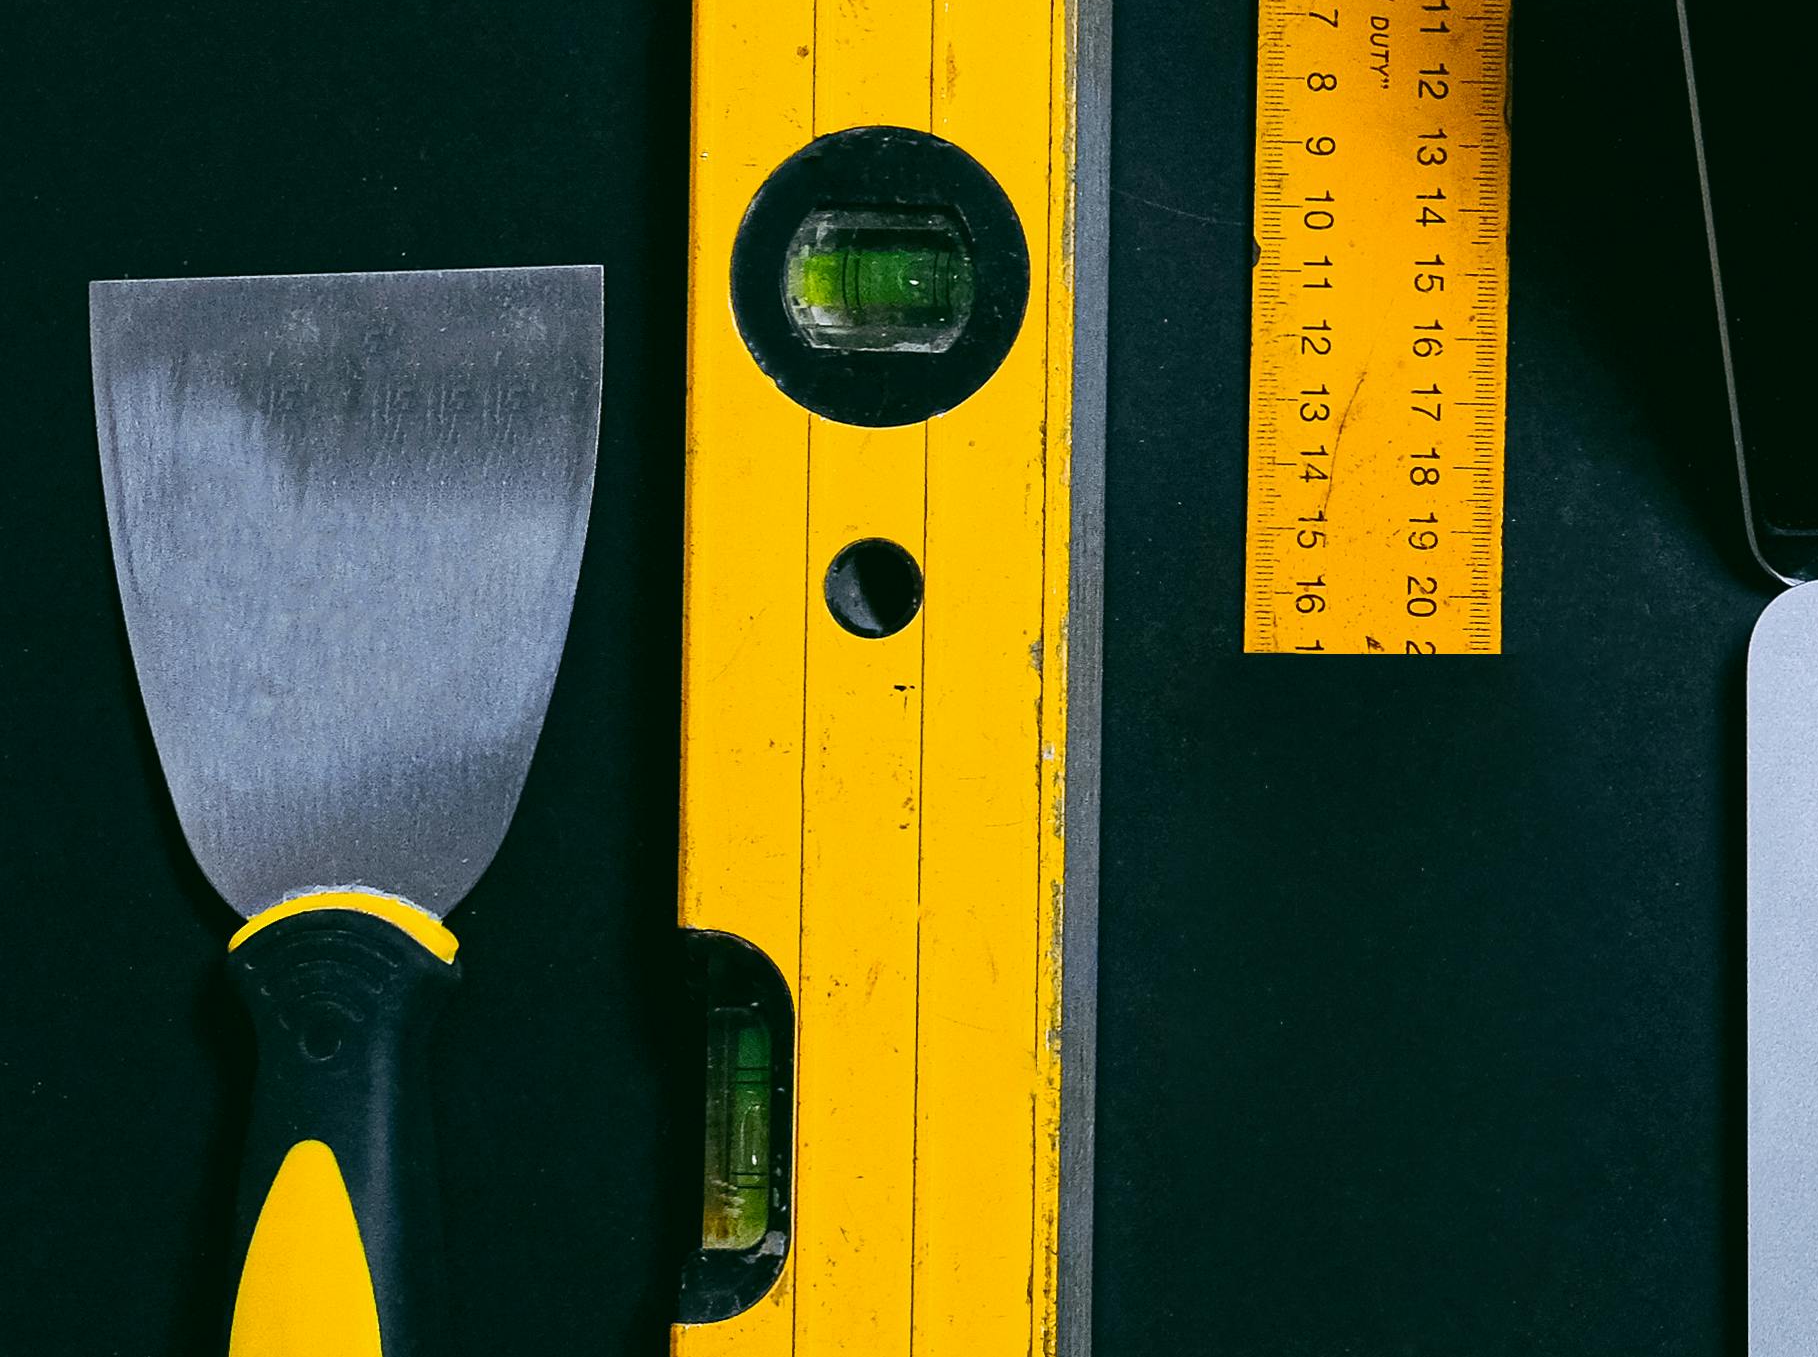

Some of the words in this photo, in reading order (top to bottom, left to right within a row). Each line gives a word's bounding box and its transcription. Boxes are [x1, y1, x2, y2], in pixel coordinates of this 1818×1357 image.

[1307, 72, 1337, 92] 8
[1418, 63, 1450, 100] 12
[1306, 137, 1336, 156] 9
[1417, 128, 1448, 166] 13
[1304, 190, 1334, 230] 10
[1416, 188, 1446, 227] 14
[1414, 254, 1445, 293] 15
[1301, 320, 1332, 355] 12
[1413, 320, 1443, 357] 16
[1300, 384, 1330, 422] 13
[1299, 445, 1329, 483] 14
[1410, 447, 1440, 486] 18
[1408, 512, 1438, 550] 19
[1296, 574, 1326, 613] 16
[1407, 576, 1437, 617] 20
